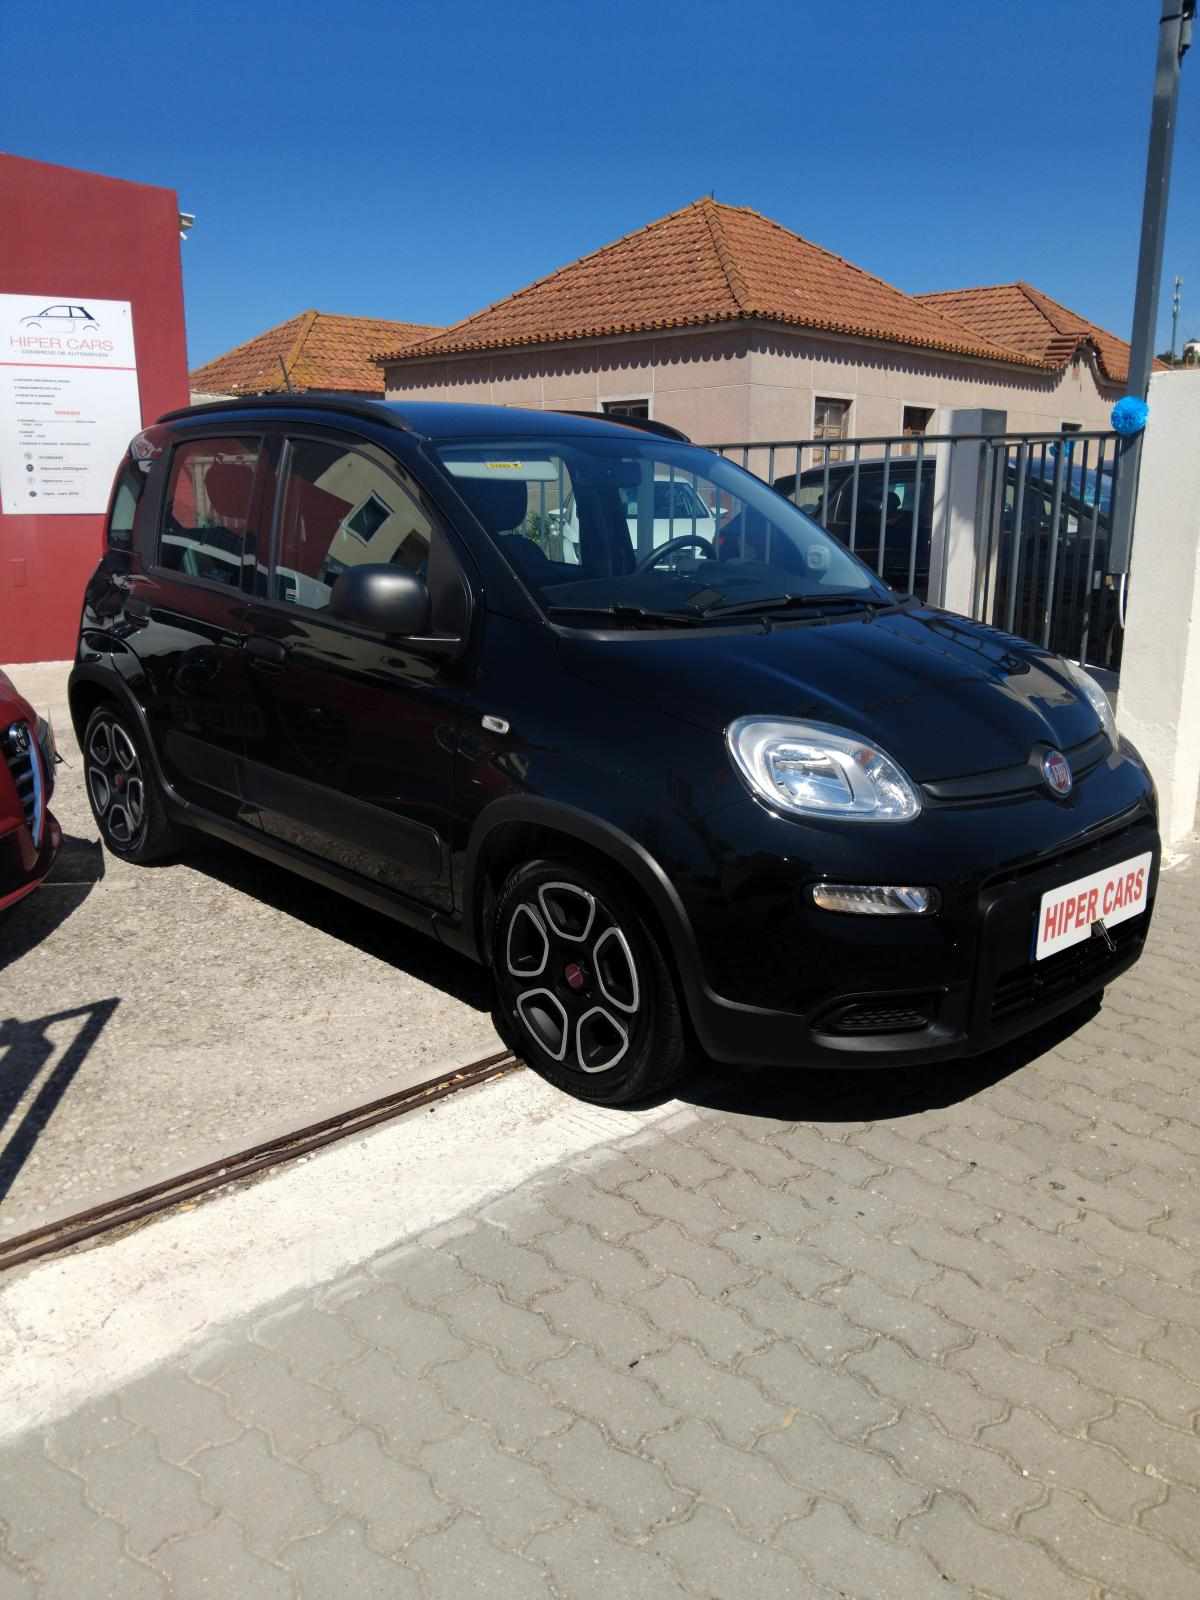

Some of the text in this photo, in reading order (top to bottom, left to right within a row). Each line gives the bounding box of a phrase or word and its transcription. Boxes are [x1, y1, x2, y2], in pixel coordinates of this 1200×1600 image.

[10, 335, 114, 352] HIPER CARS
[1043, 868, 1145, 943] HIPER CARS
